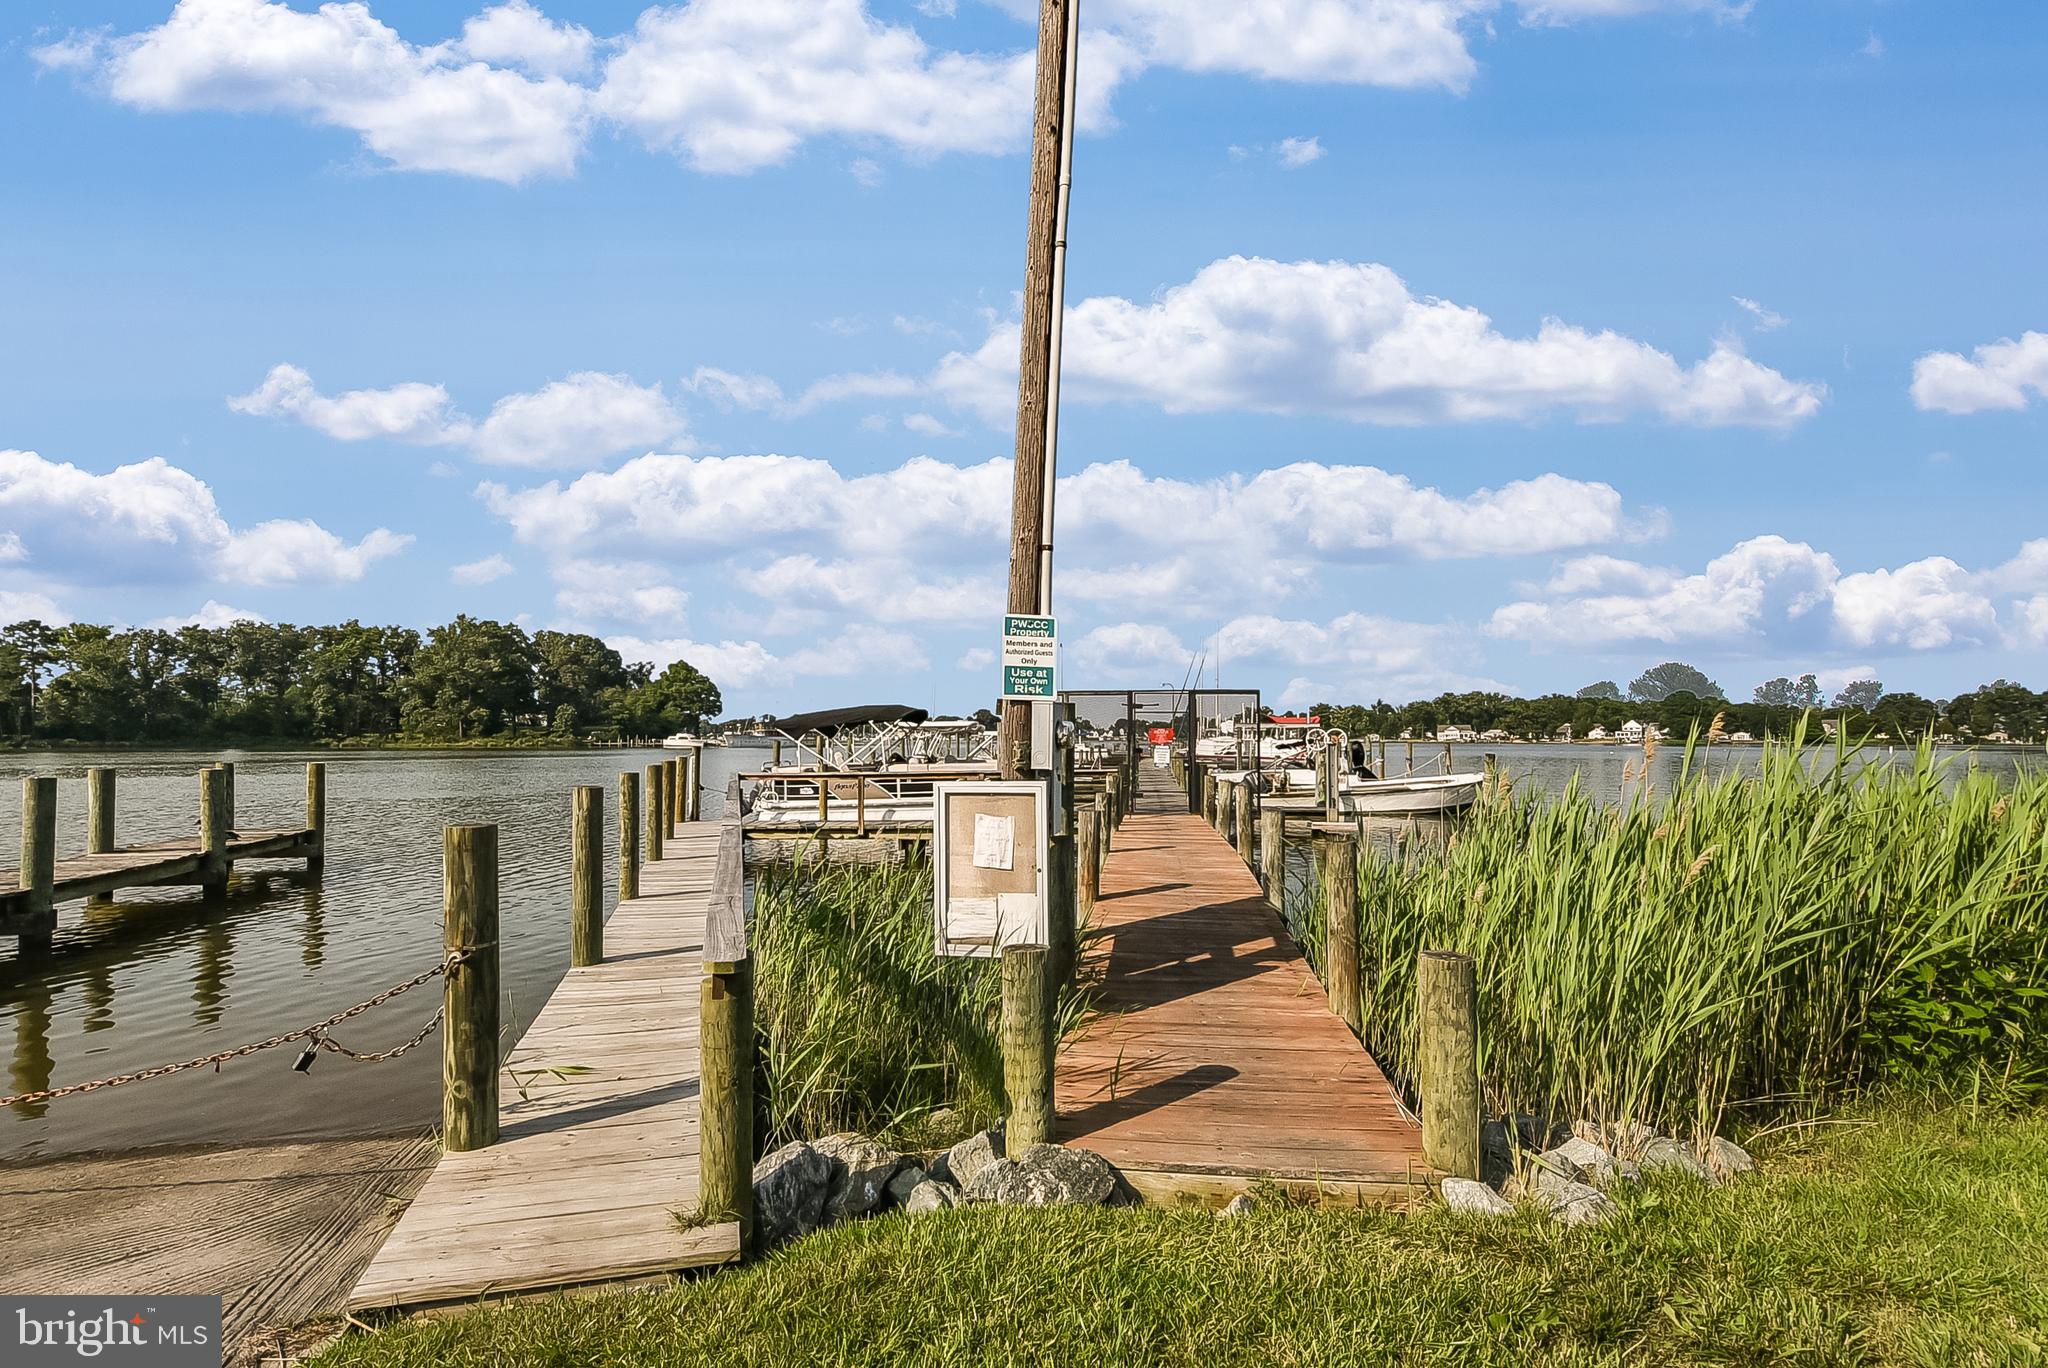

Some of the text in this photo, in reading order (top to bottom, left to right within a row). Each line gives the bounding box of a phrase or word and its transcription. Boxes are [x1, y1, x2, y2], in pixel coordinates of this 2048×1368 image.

[1010, 628, 1049, 638] Property
[1021, 658, 1038, 666] Only
[1011, 668, 1047, 677] Use at
[1030, 677, 1048, 685] Own
[1014, 684, 1044, 694] Risk
